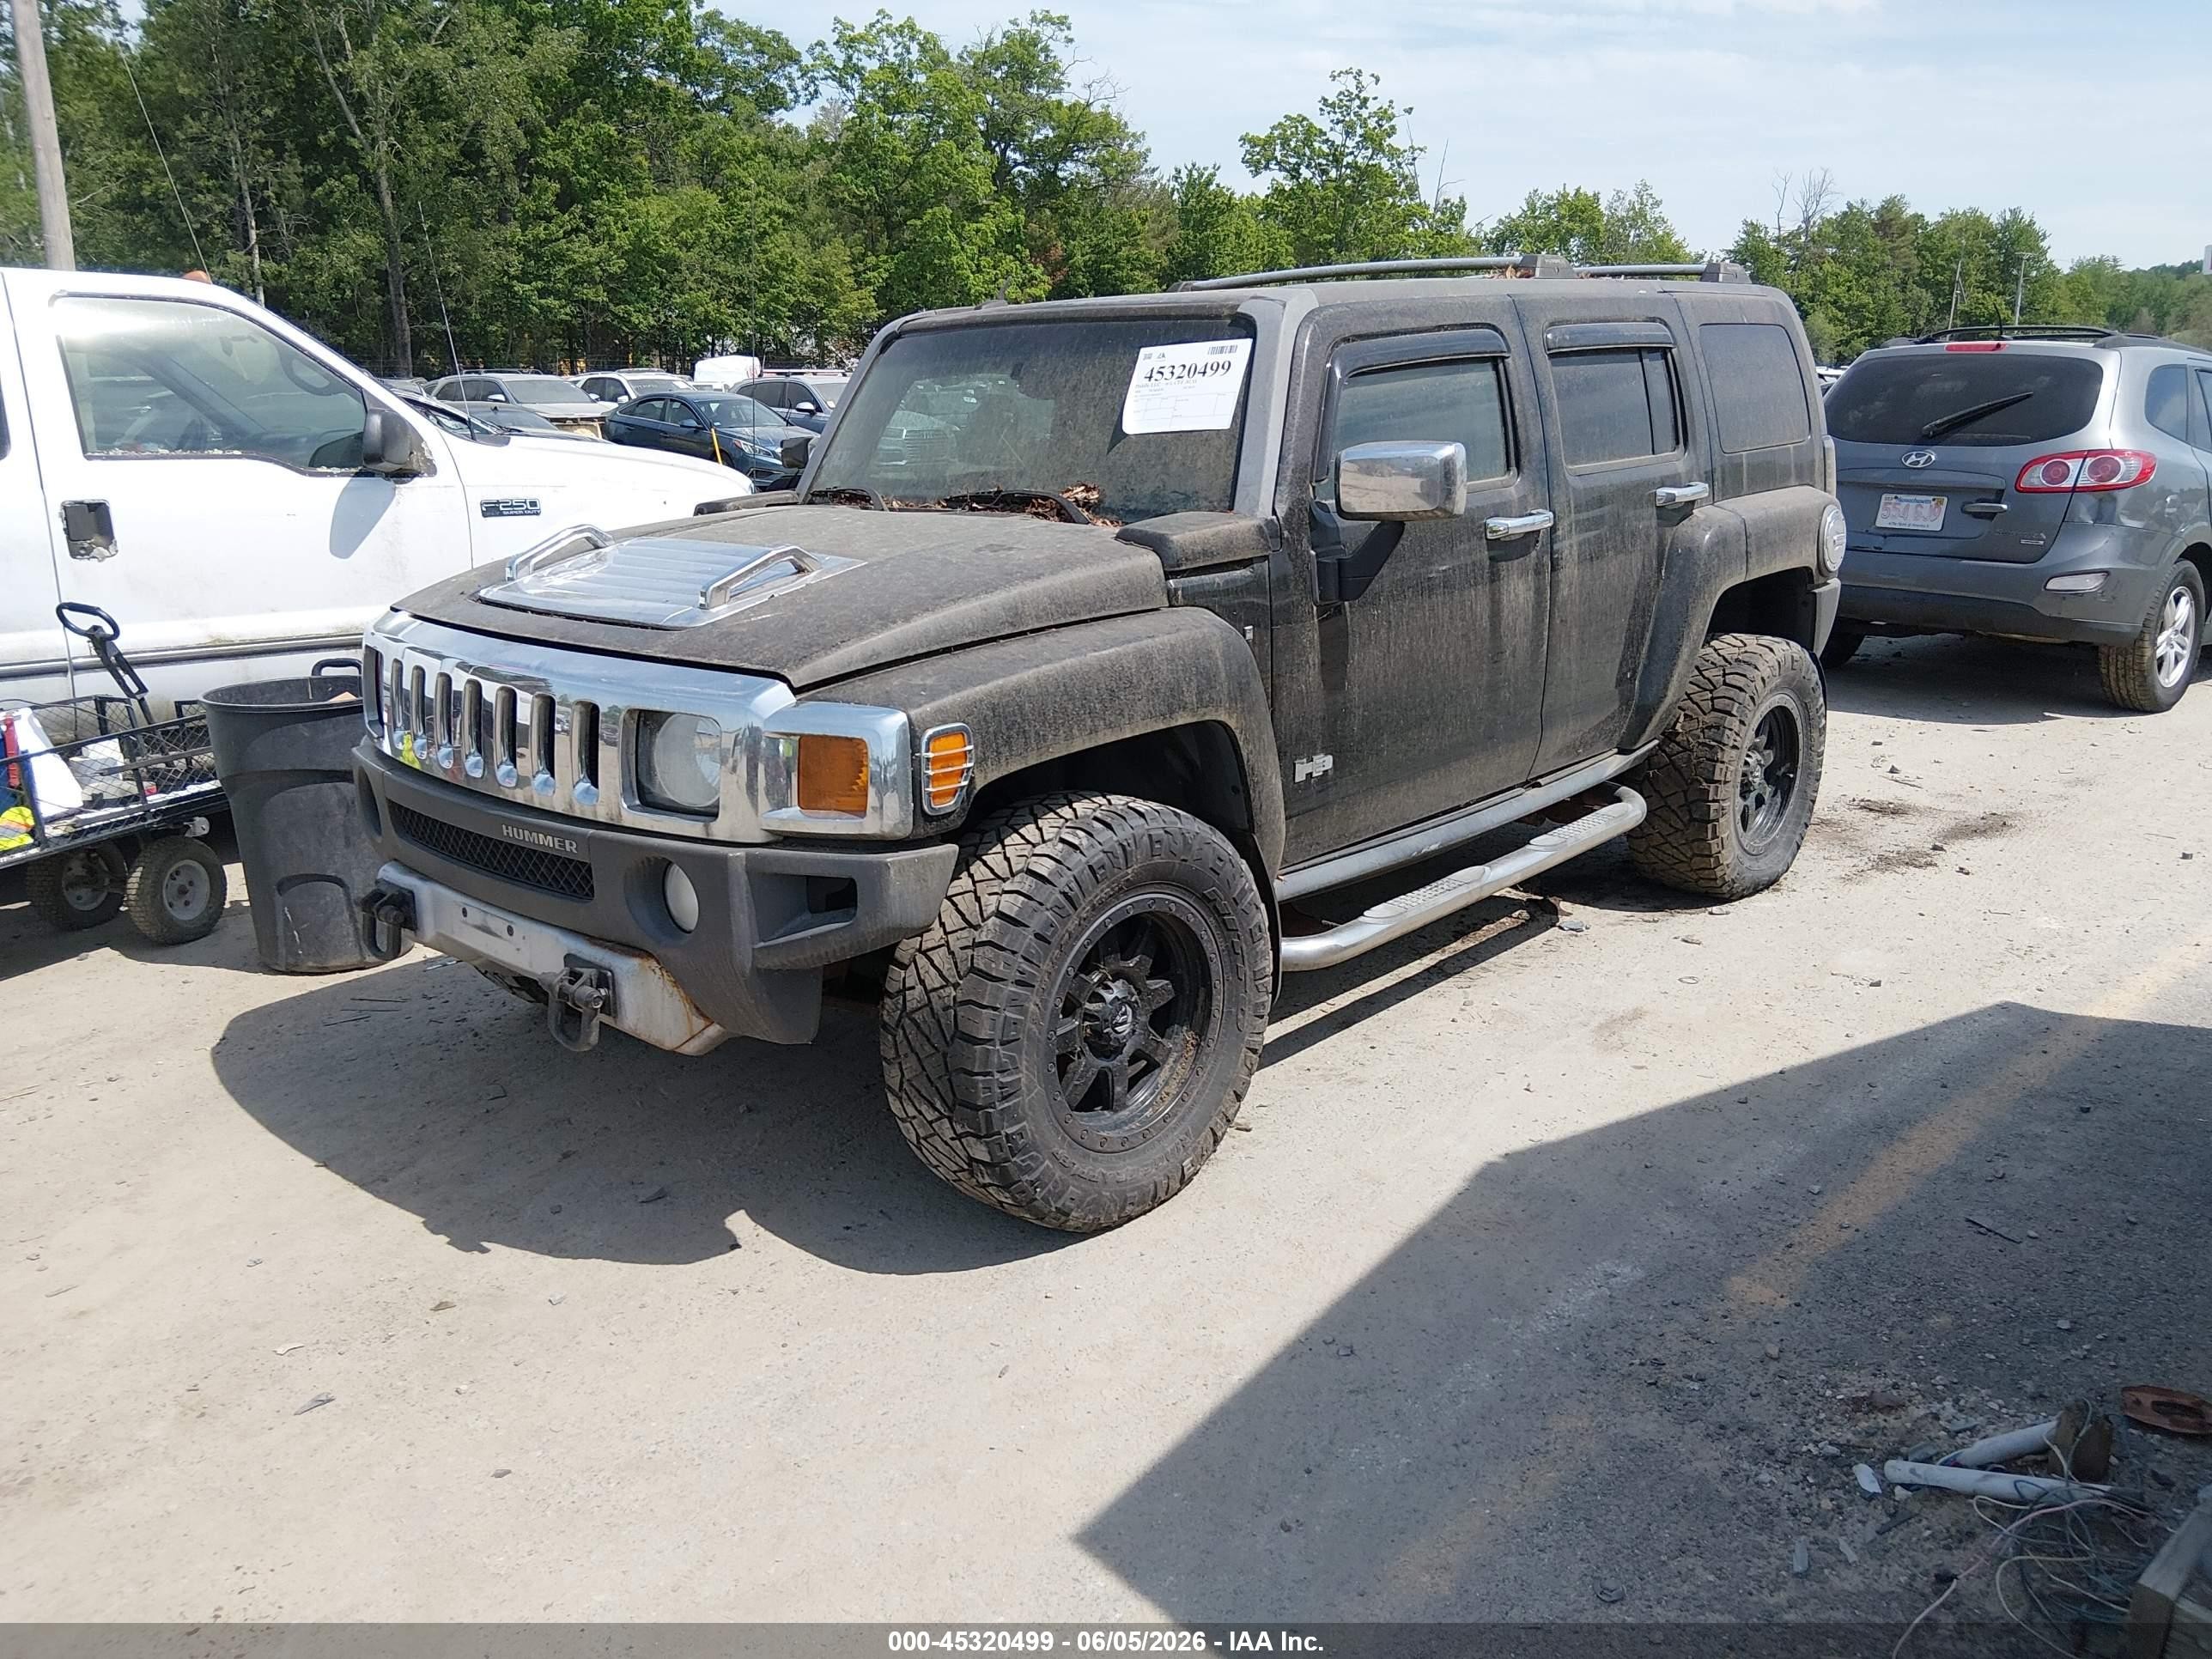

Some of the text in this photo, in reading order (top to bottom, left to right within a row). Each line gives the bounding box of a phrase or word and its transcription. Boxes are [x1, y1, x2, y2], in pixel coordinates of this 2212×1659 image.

[1144, 360, 1231, 382] 45320499
[1294, 755, 1333, 782] H3
[501, 823, 577, 854] HUMMER
